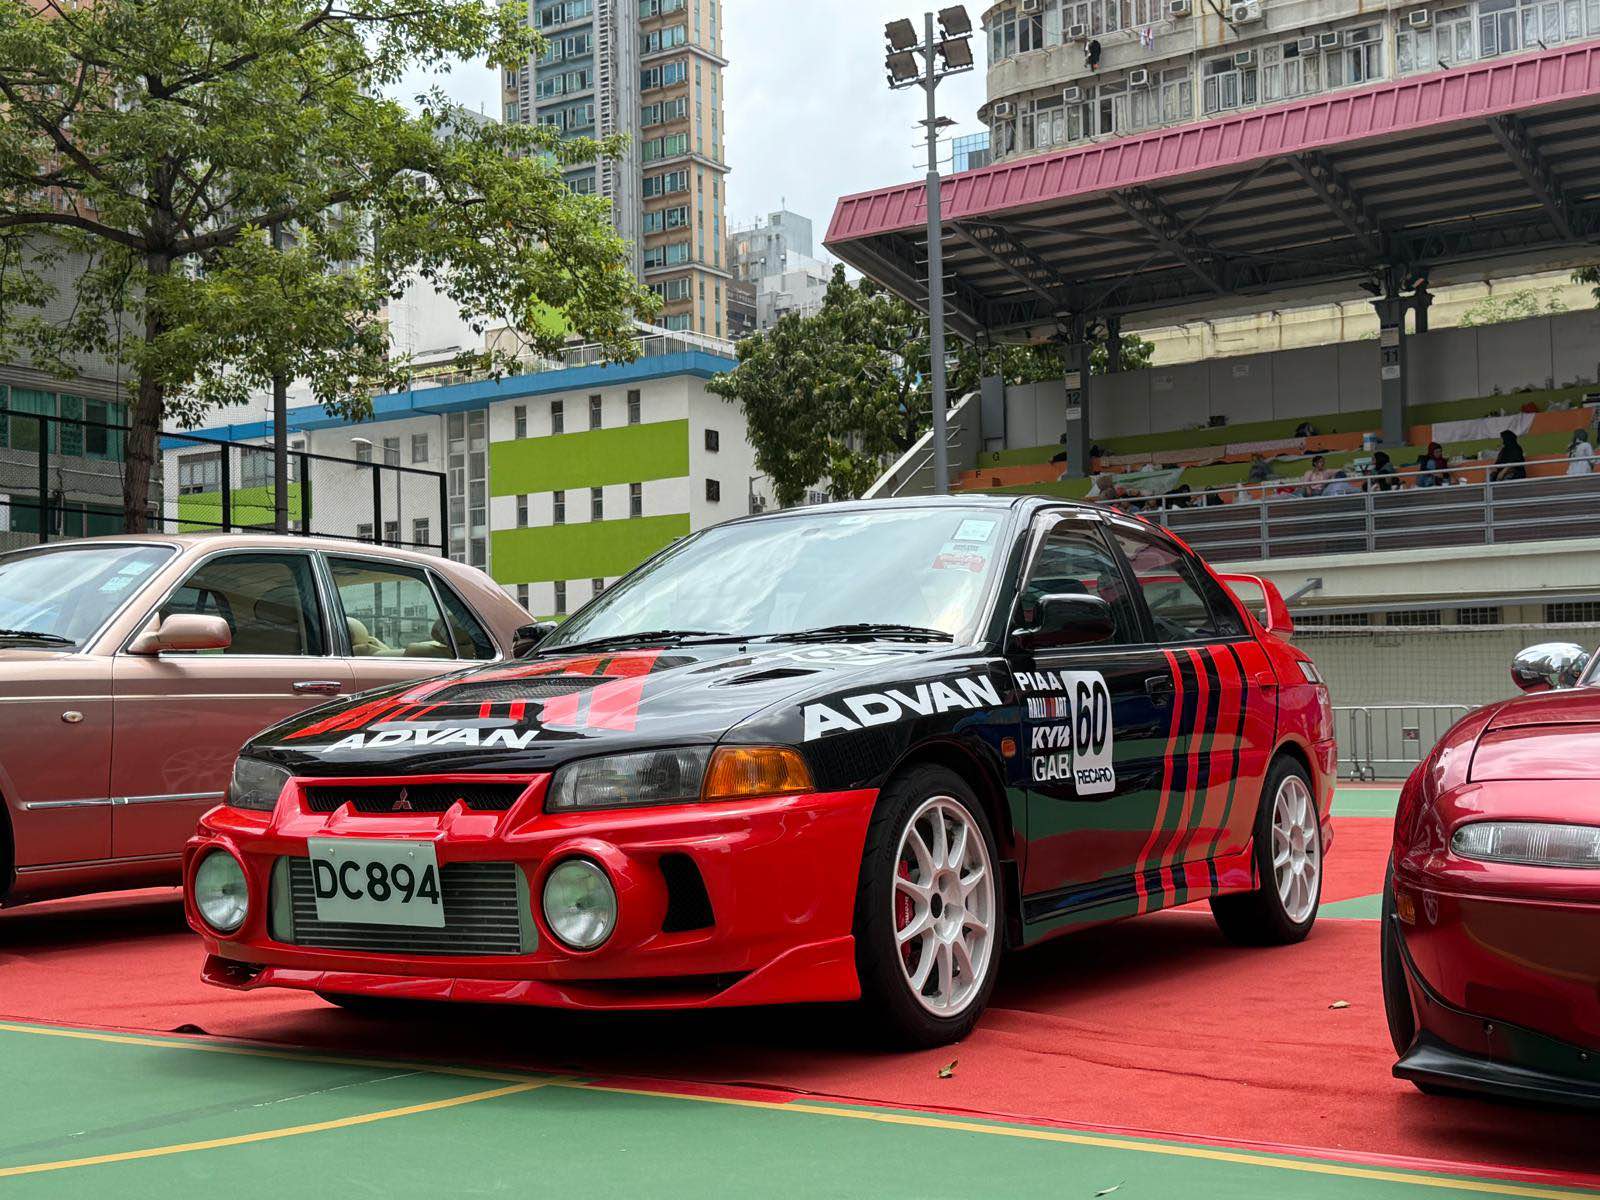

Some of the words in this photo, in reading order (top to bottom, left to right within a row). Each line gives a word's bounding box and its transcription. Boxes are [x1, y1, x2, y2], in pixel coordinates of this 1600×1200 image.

[1066, 392, 1080, 405] 12
[1013, 671, 1063, 691] PIAA
[803, 674, 1003, 742] ADVAN
[1076, 680, 1108, 757] 60
[321, 727, 540, 753] ADVAN
[1031, 725, 1071, 750] KYB
[1032, 753, 1073, 782] GAB
[1076, 767, 1113, 785] RECARO
[312, 858, 440, 905] DC894
